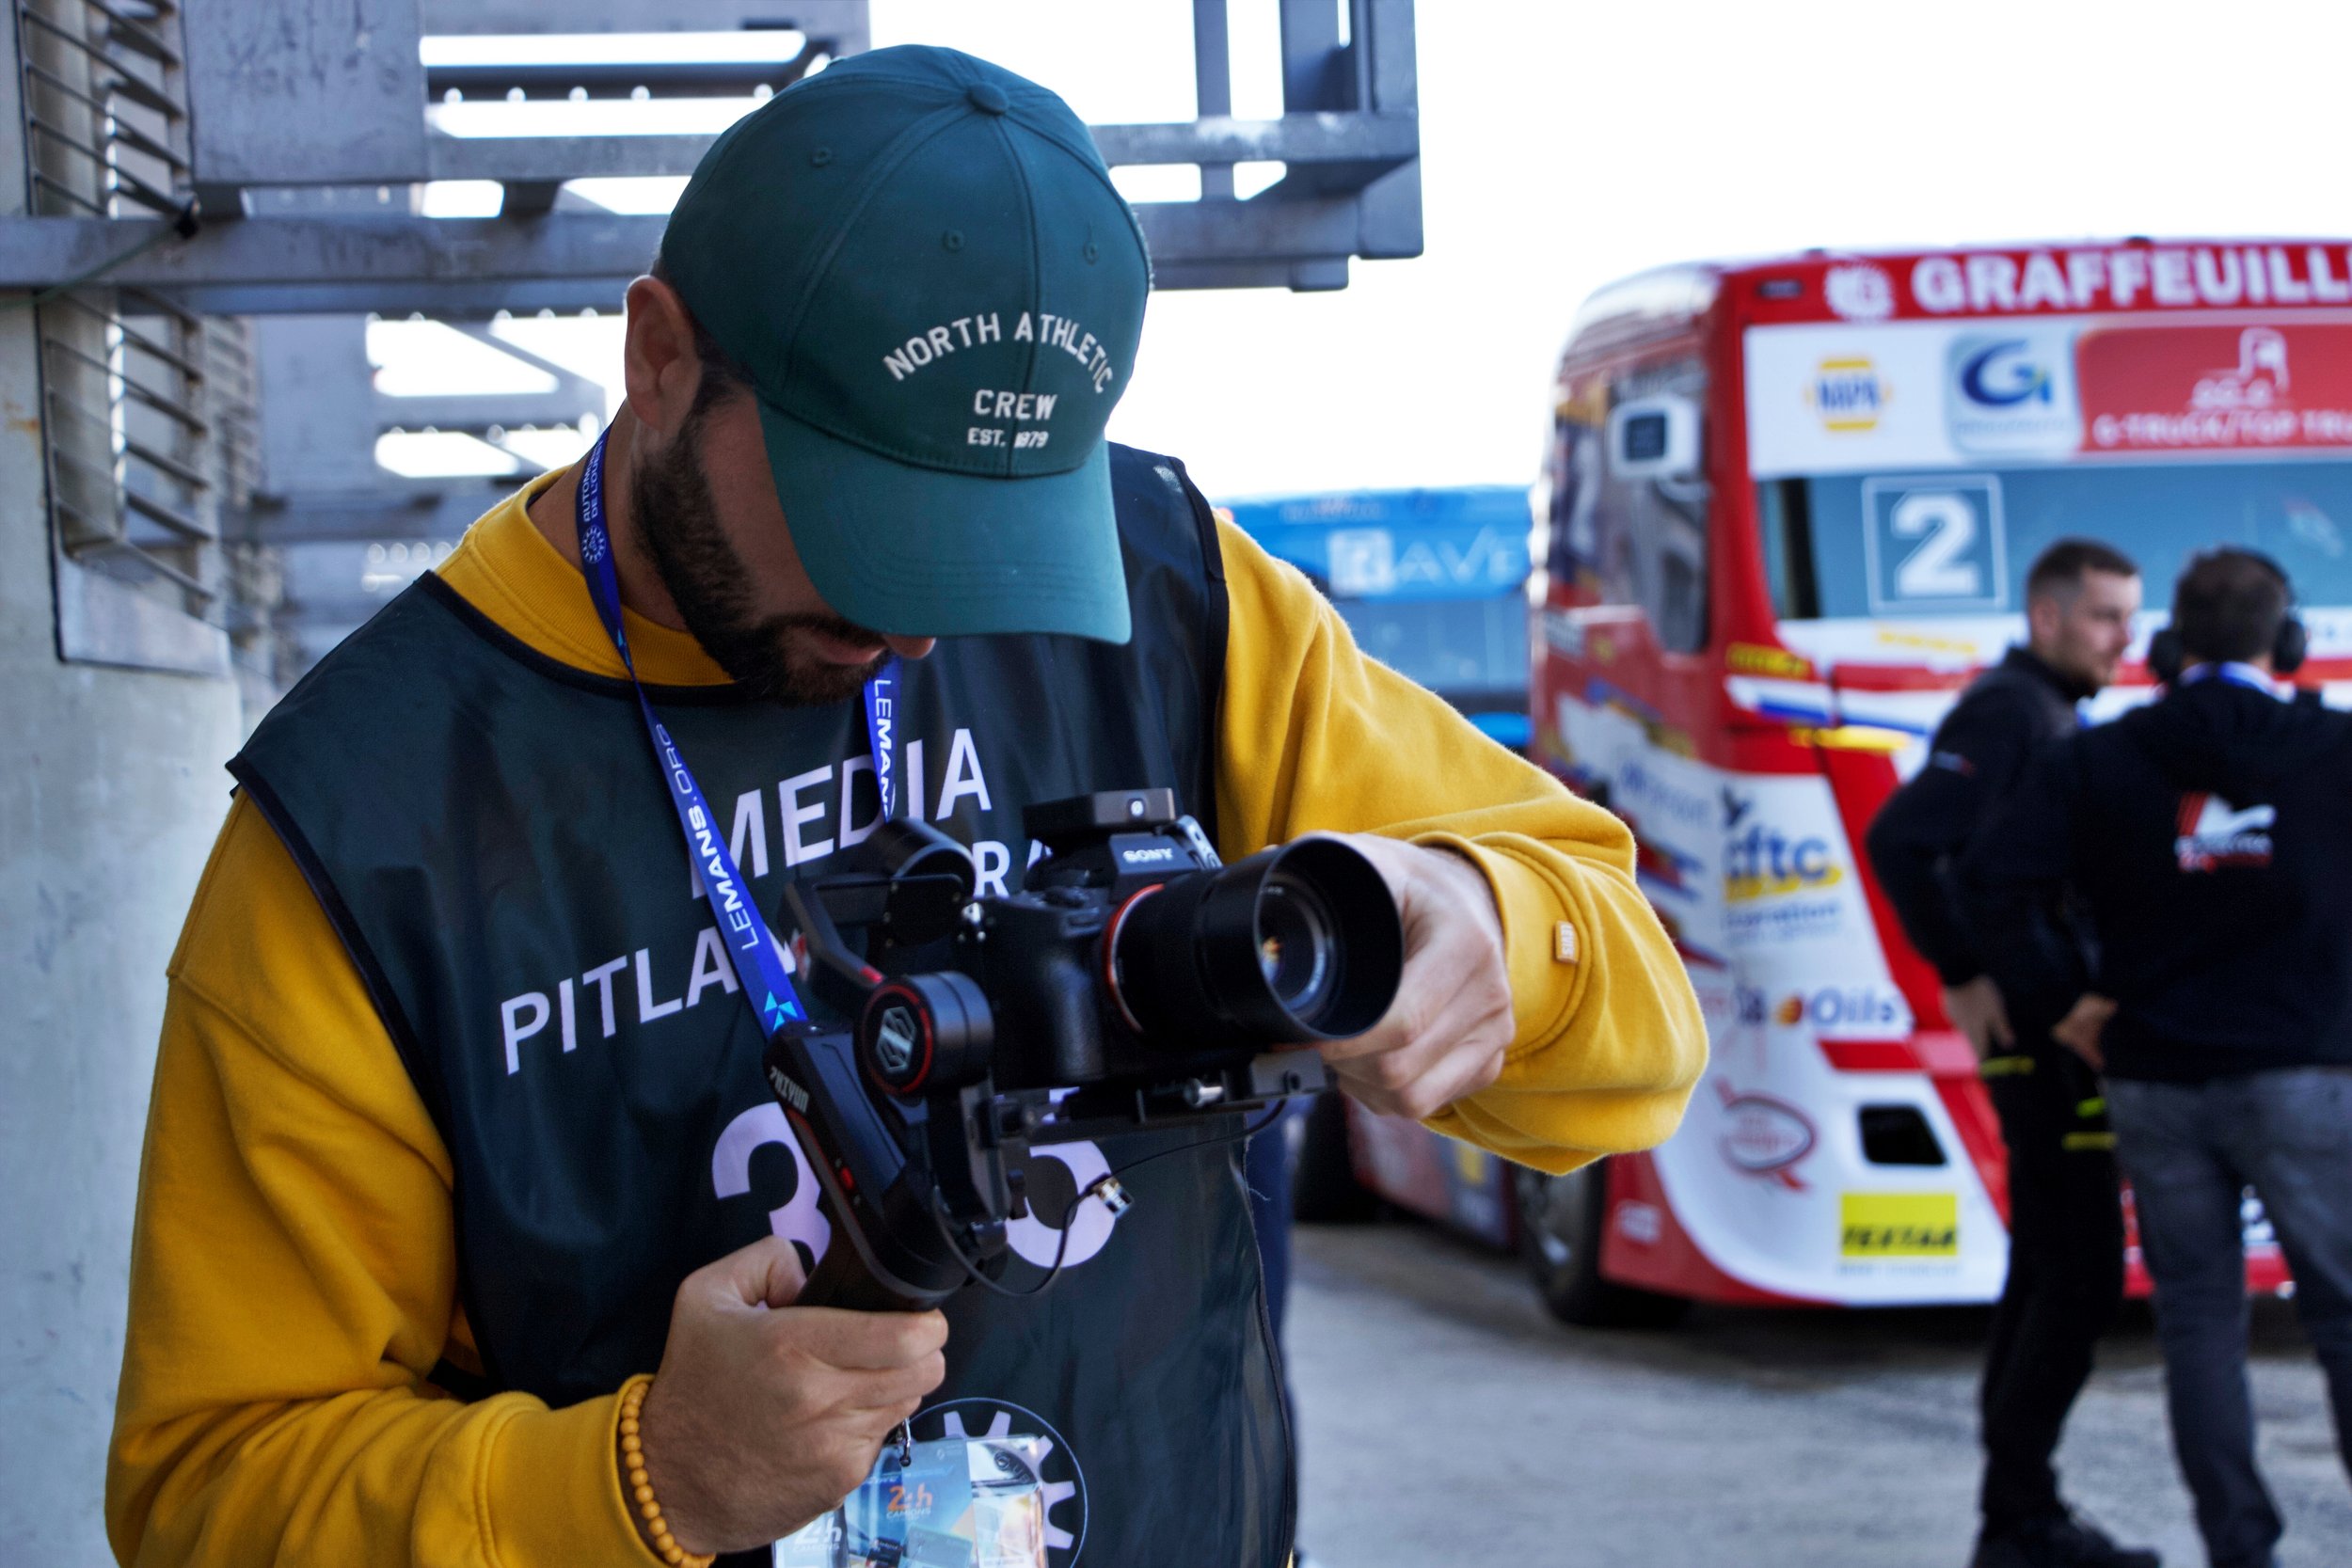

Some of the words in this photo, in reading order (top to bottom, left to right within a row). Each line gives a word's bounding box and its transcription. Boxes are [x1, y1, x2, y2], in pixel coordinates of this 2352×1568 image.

[1910, 245, 2352, 312] GRAFFEUILL
[882, 311, 1000, 382] NORTH
[1014, 311, 1114, 394] ATHLETIC
[974, 388, 1057, 420] CREW
[967, 427, 1007, 448] EST.
[1013, 430, 1049, 449] 1979
[1890, 494, 1976, 597] 2
[690, 728, 993, 899] MEDIA
[1122, 847, 1173, 863] SONY
